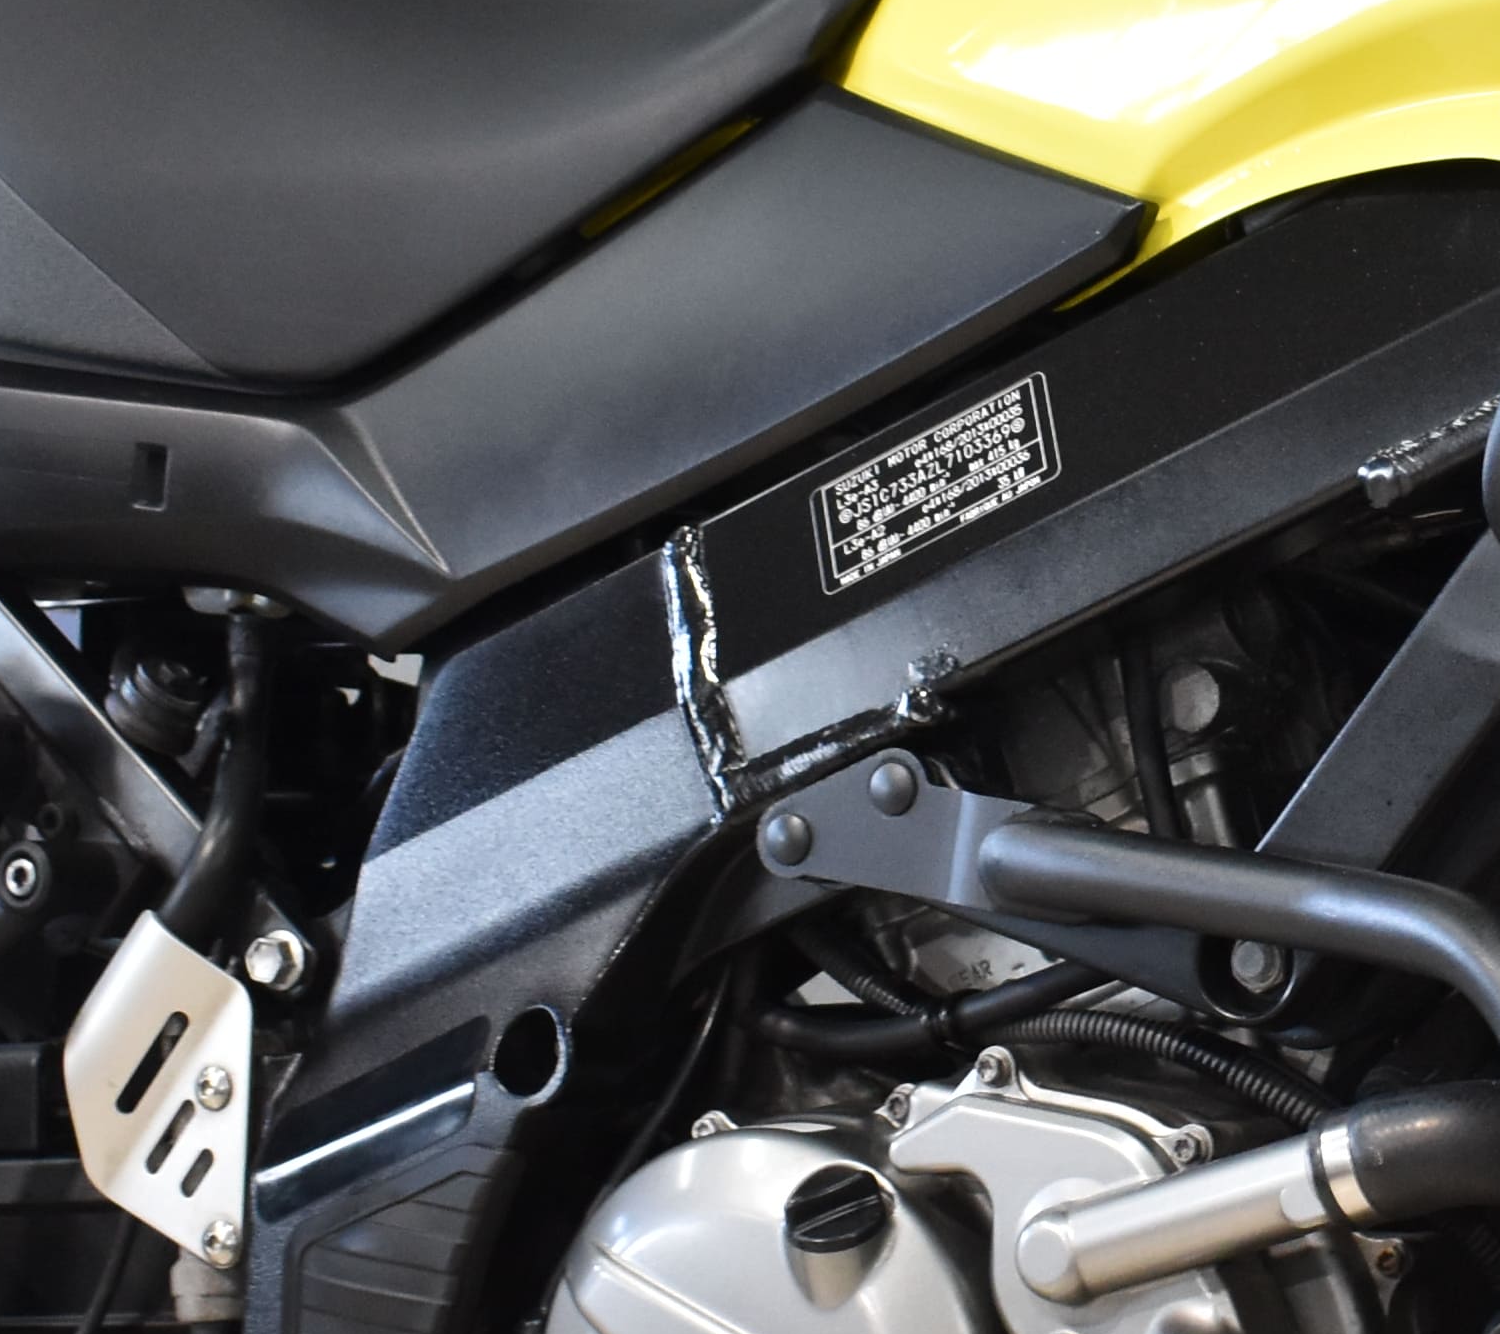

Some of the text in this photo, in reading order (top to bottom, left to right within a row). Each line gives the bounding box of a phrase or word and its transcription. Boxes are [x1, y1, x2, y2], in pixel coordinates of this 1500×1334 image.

[835, 389, 1021, 495] SUZUKI MOTOR CORPORATION
[875, 548, 902, 566] JAPAN
